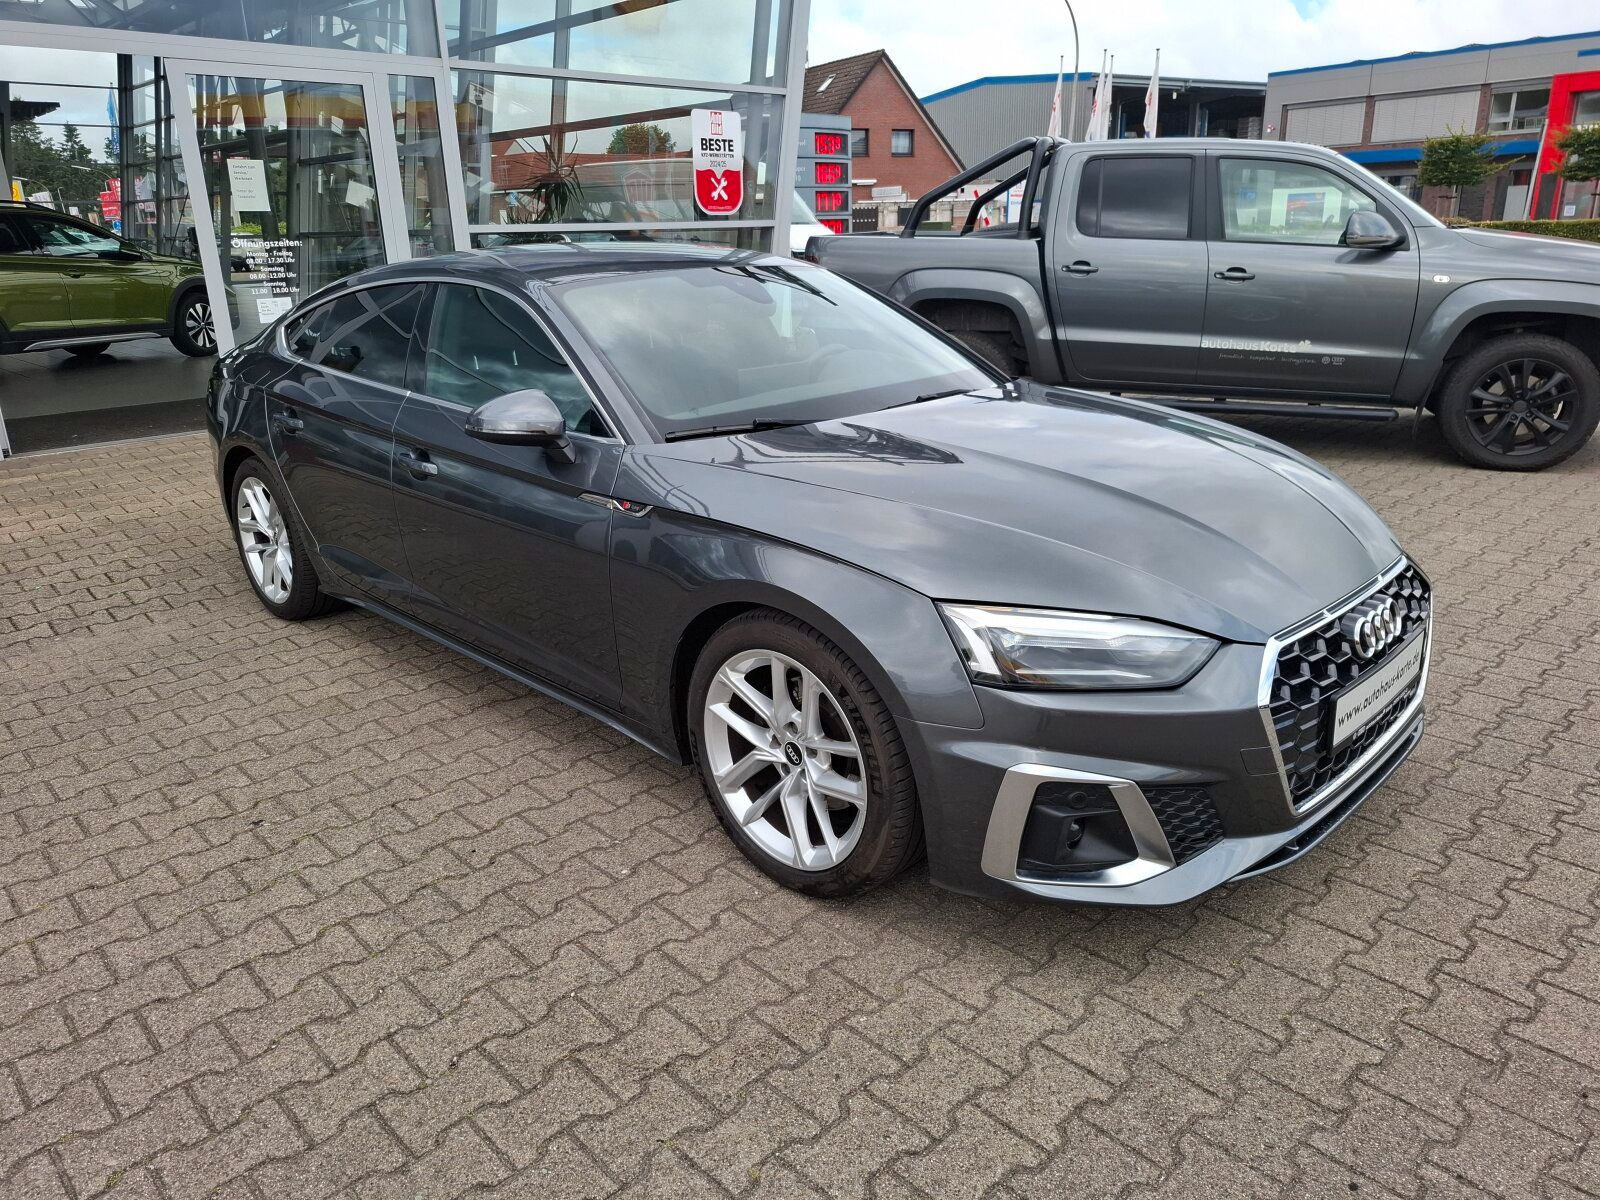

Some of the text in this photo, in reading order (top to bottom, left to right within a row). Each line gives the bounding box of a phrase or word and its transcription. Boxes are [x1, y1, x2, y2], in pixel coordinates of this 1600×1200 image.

[700, 137, 734, 152] BESTE
[232, 237, 303, 250] Öffnungszeiten:
[246, 251, 269, 259] Montag
[1201, 339, 1298, 353] autohaus Korte
[1338, 648, 1420, 727] www.autohaus-korte.de
